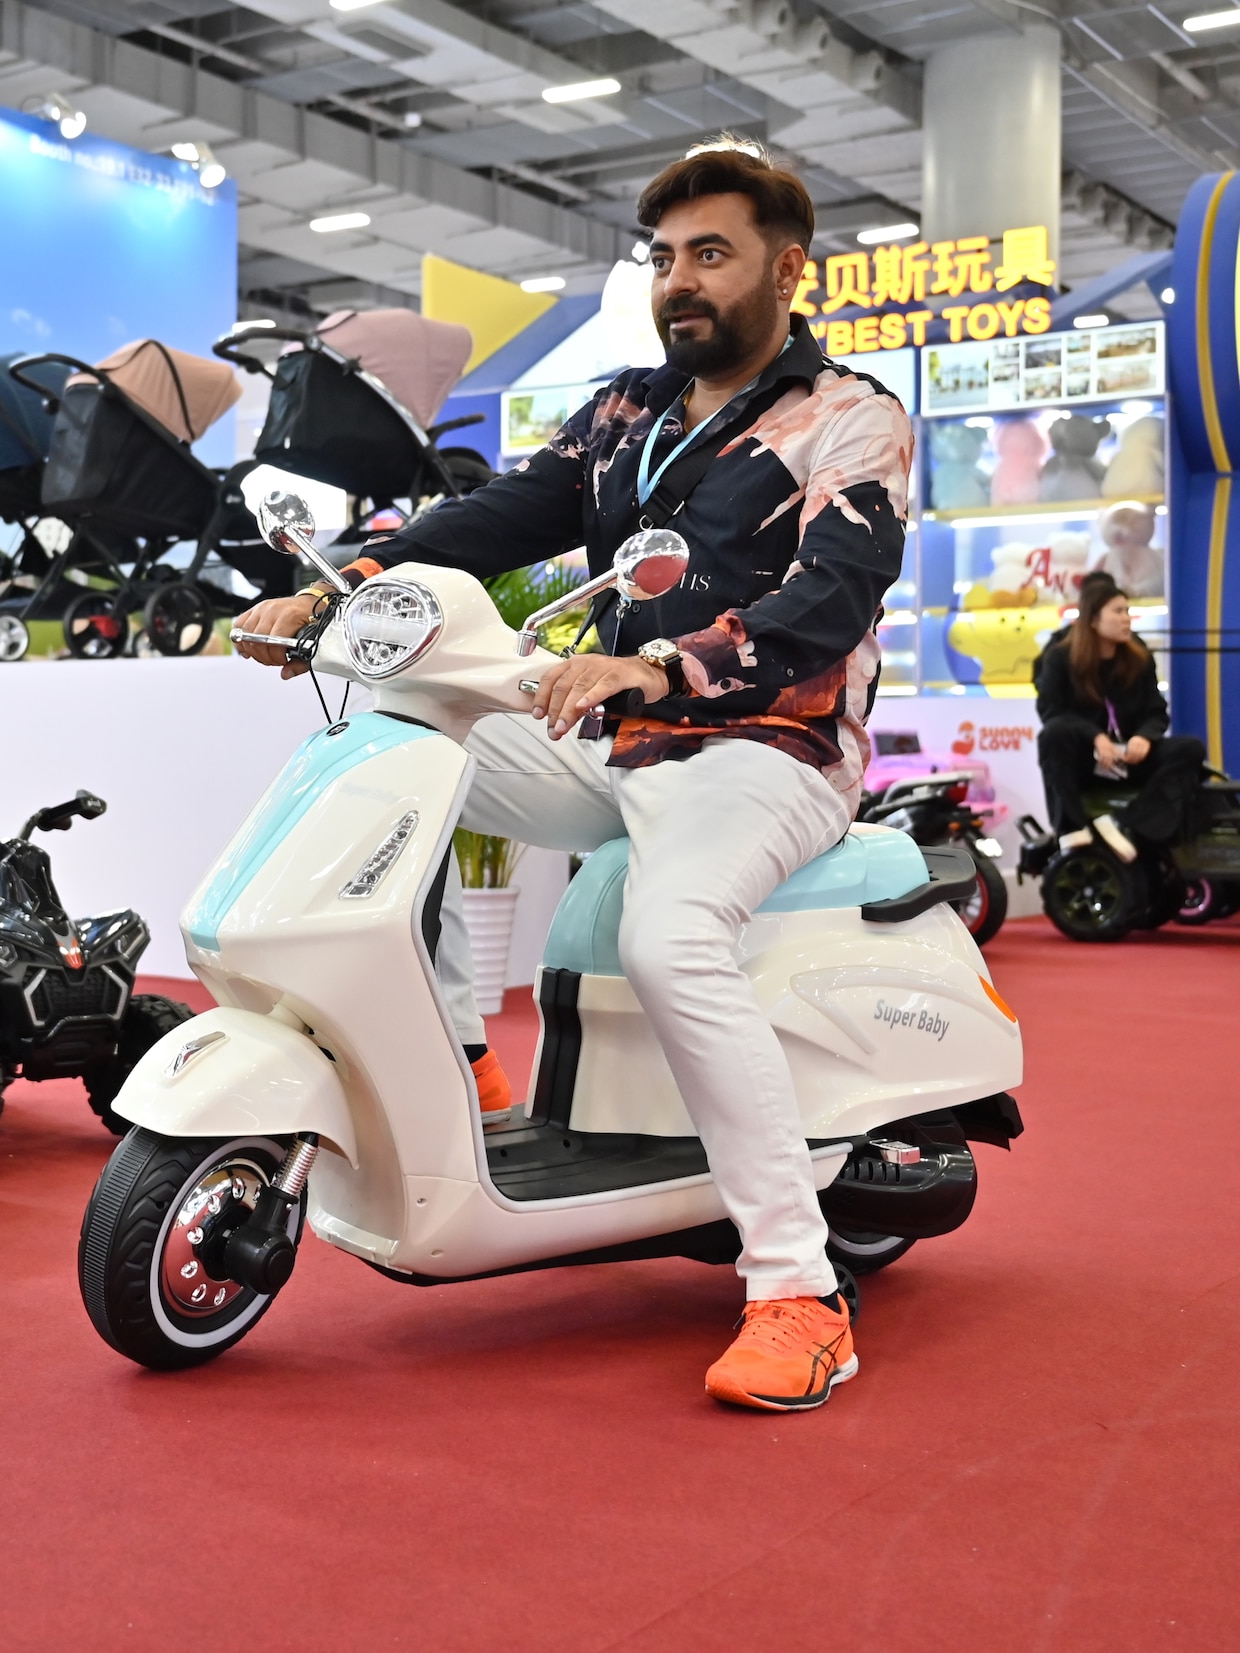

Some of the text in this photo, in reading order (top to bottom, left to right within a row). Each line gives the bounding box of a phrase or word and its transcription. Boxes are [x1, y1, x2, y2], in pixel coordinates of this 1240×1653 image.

[810, 297, 1051, 357] 'BEST TOYS
[980, 739, 1021, 751] LOVE
[874, 998, 950, 1042] Super Baby
